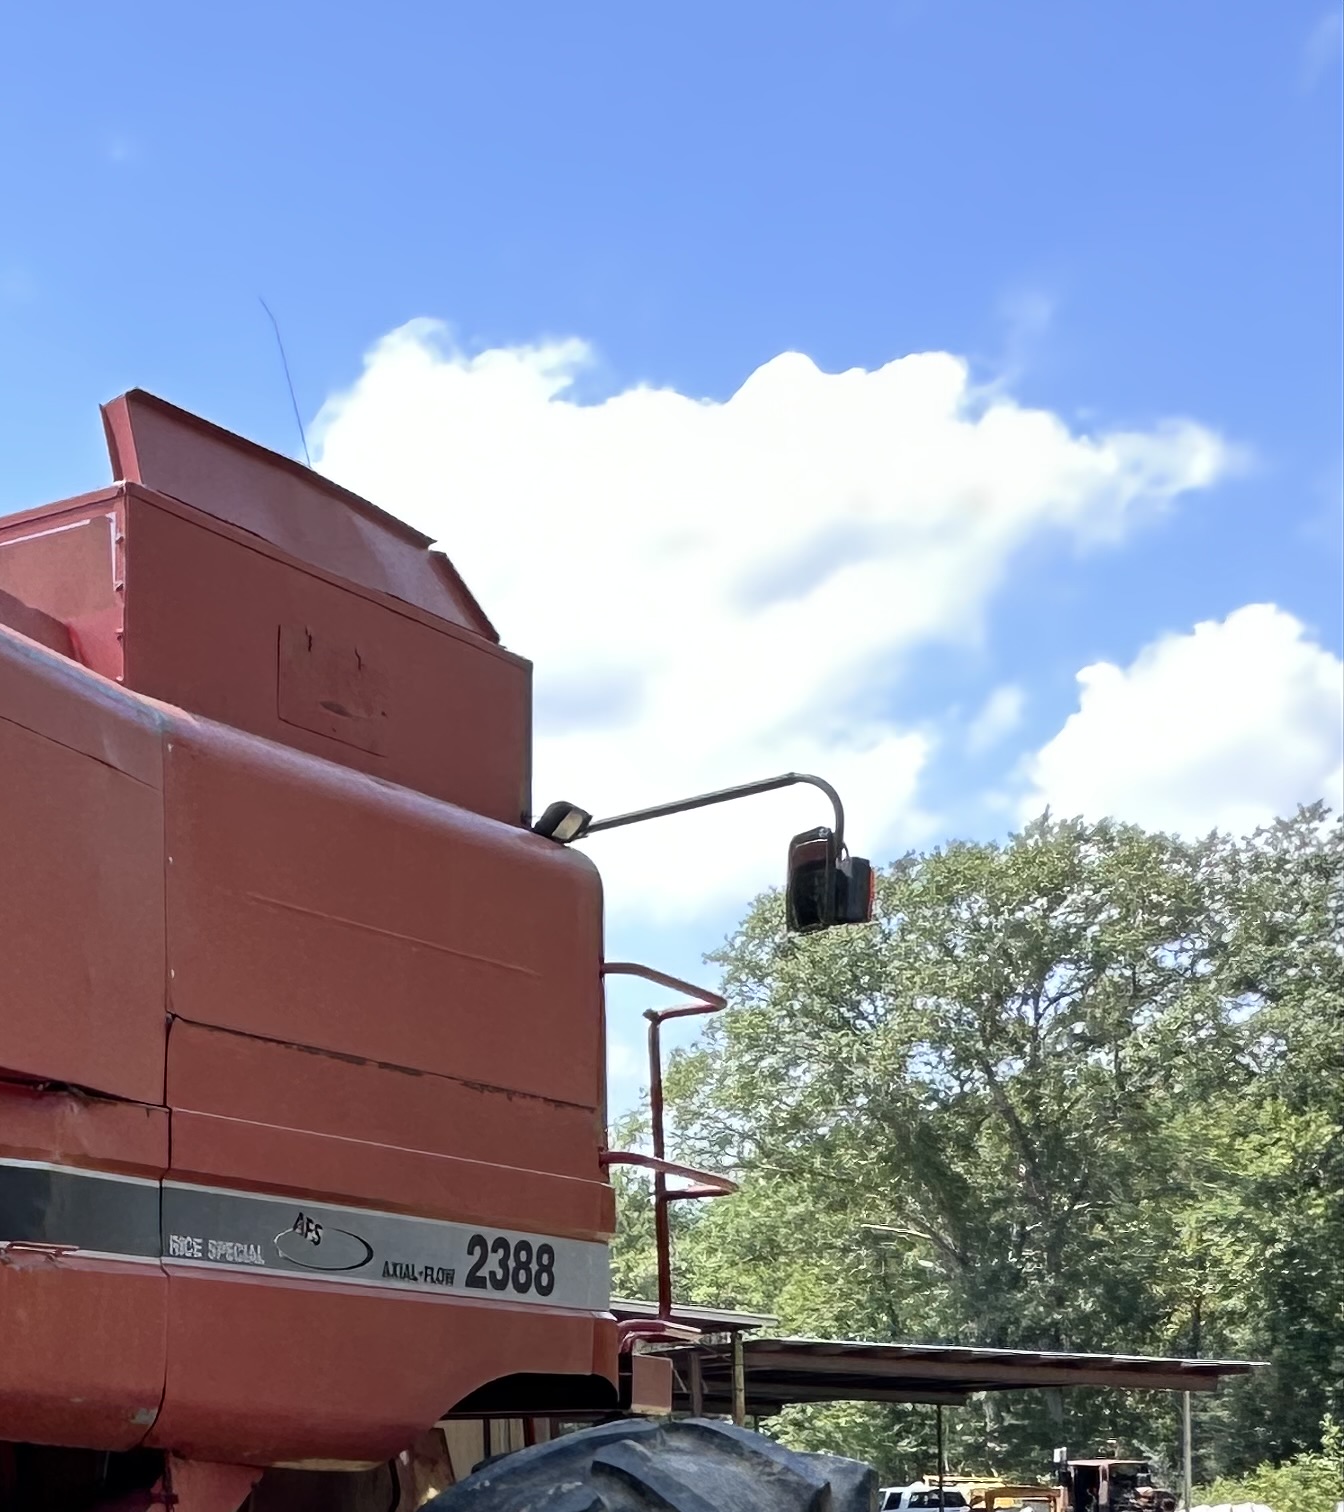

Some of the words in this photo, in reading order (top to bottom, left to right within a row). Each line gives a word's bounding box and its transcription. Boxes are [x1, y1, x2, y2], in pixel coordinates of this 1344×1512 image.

[292, 1211, 323, 1246] AFS
[169, 1234, 203, 1258] RICE
[208, 1239, 265, 1265] SPECIAL
[465, 1234, 555, 1297] 2388
